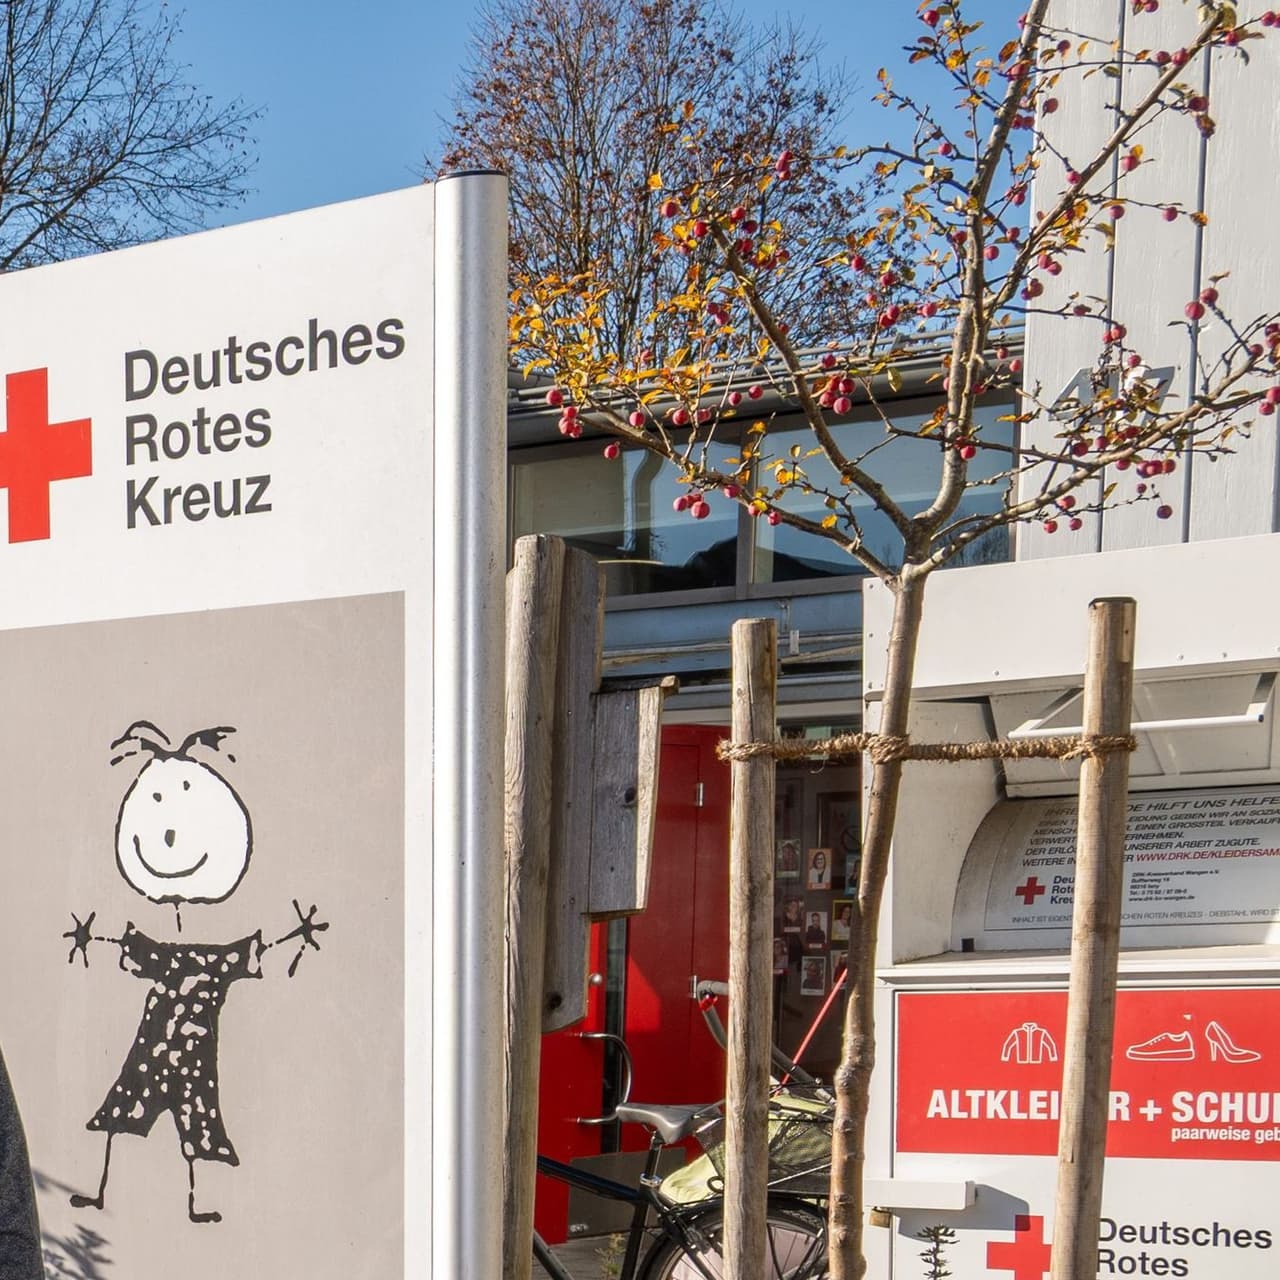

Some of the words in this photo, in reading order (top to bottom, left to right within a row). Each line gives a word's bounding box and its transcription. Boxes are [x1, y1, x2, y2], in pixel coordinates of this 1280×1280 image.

[124, 317, 406, 402] Deutsches
[125, 407, 273, 466] Rotes
[126, 475, 272, 530] Kreuz
[1146, 801, 1191, 812] HILFT
[1193, 799, 1227, 809] UNS
[1169, 812, 1207, 821] GEBEN
[1134, 823, 1166, 831] EINEN
[1168, 820, 1226, 830] GROSSTEIL
[1024, 847, 1047, 856] DER
[1047, 845, 1078, 855] ERLÖ
[1124, 841, 1175, 851] UNSERER
[1174, 839, 1214, 849] ARBEIT
[1214, 837, 1261, 847] ZUGUTE.
[1022, 857, 1065, 867] WEITERE
[926, 1089, 1131, 1121] ALTKLEIR
[1171, 1126, 1251, 1142] paarweise
[1098, 1218, 1273, 1249] Deutsches
[1096, 1248, 1189, 1277] Rotes
